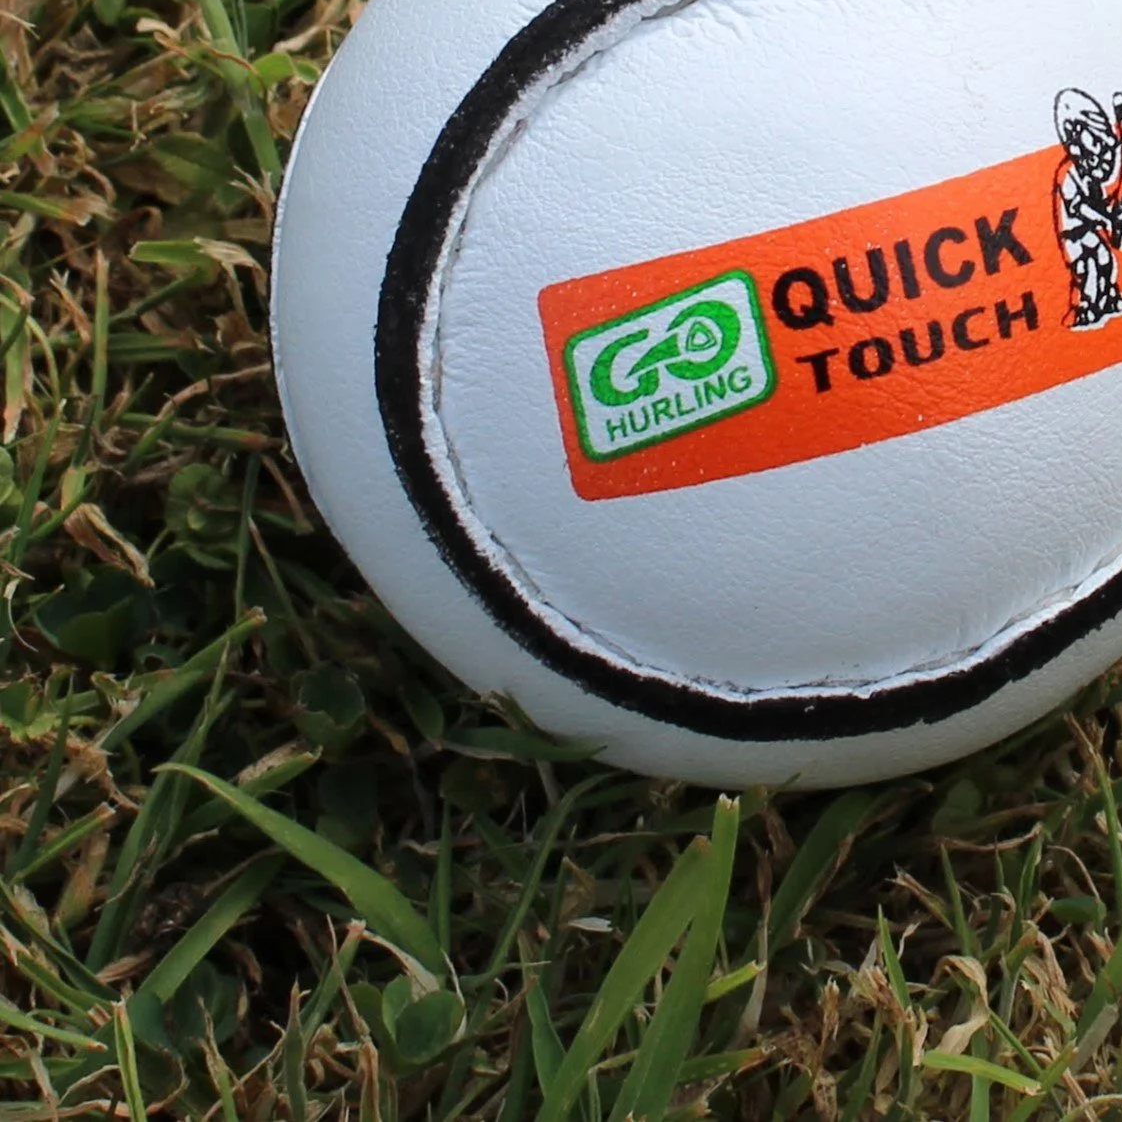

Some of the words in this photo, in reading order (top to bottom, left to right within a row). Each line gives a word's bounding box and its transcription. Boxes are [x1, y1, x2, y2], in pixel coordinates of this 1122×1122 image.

[771, 208, 1032, 330] QUICK
[590, 301, 741, 406] GO
[796, 291, 1038, 393] TOUCH
[607, 365, 752, 441] HURLING
